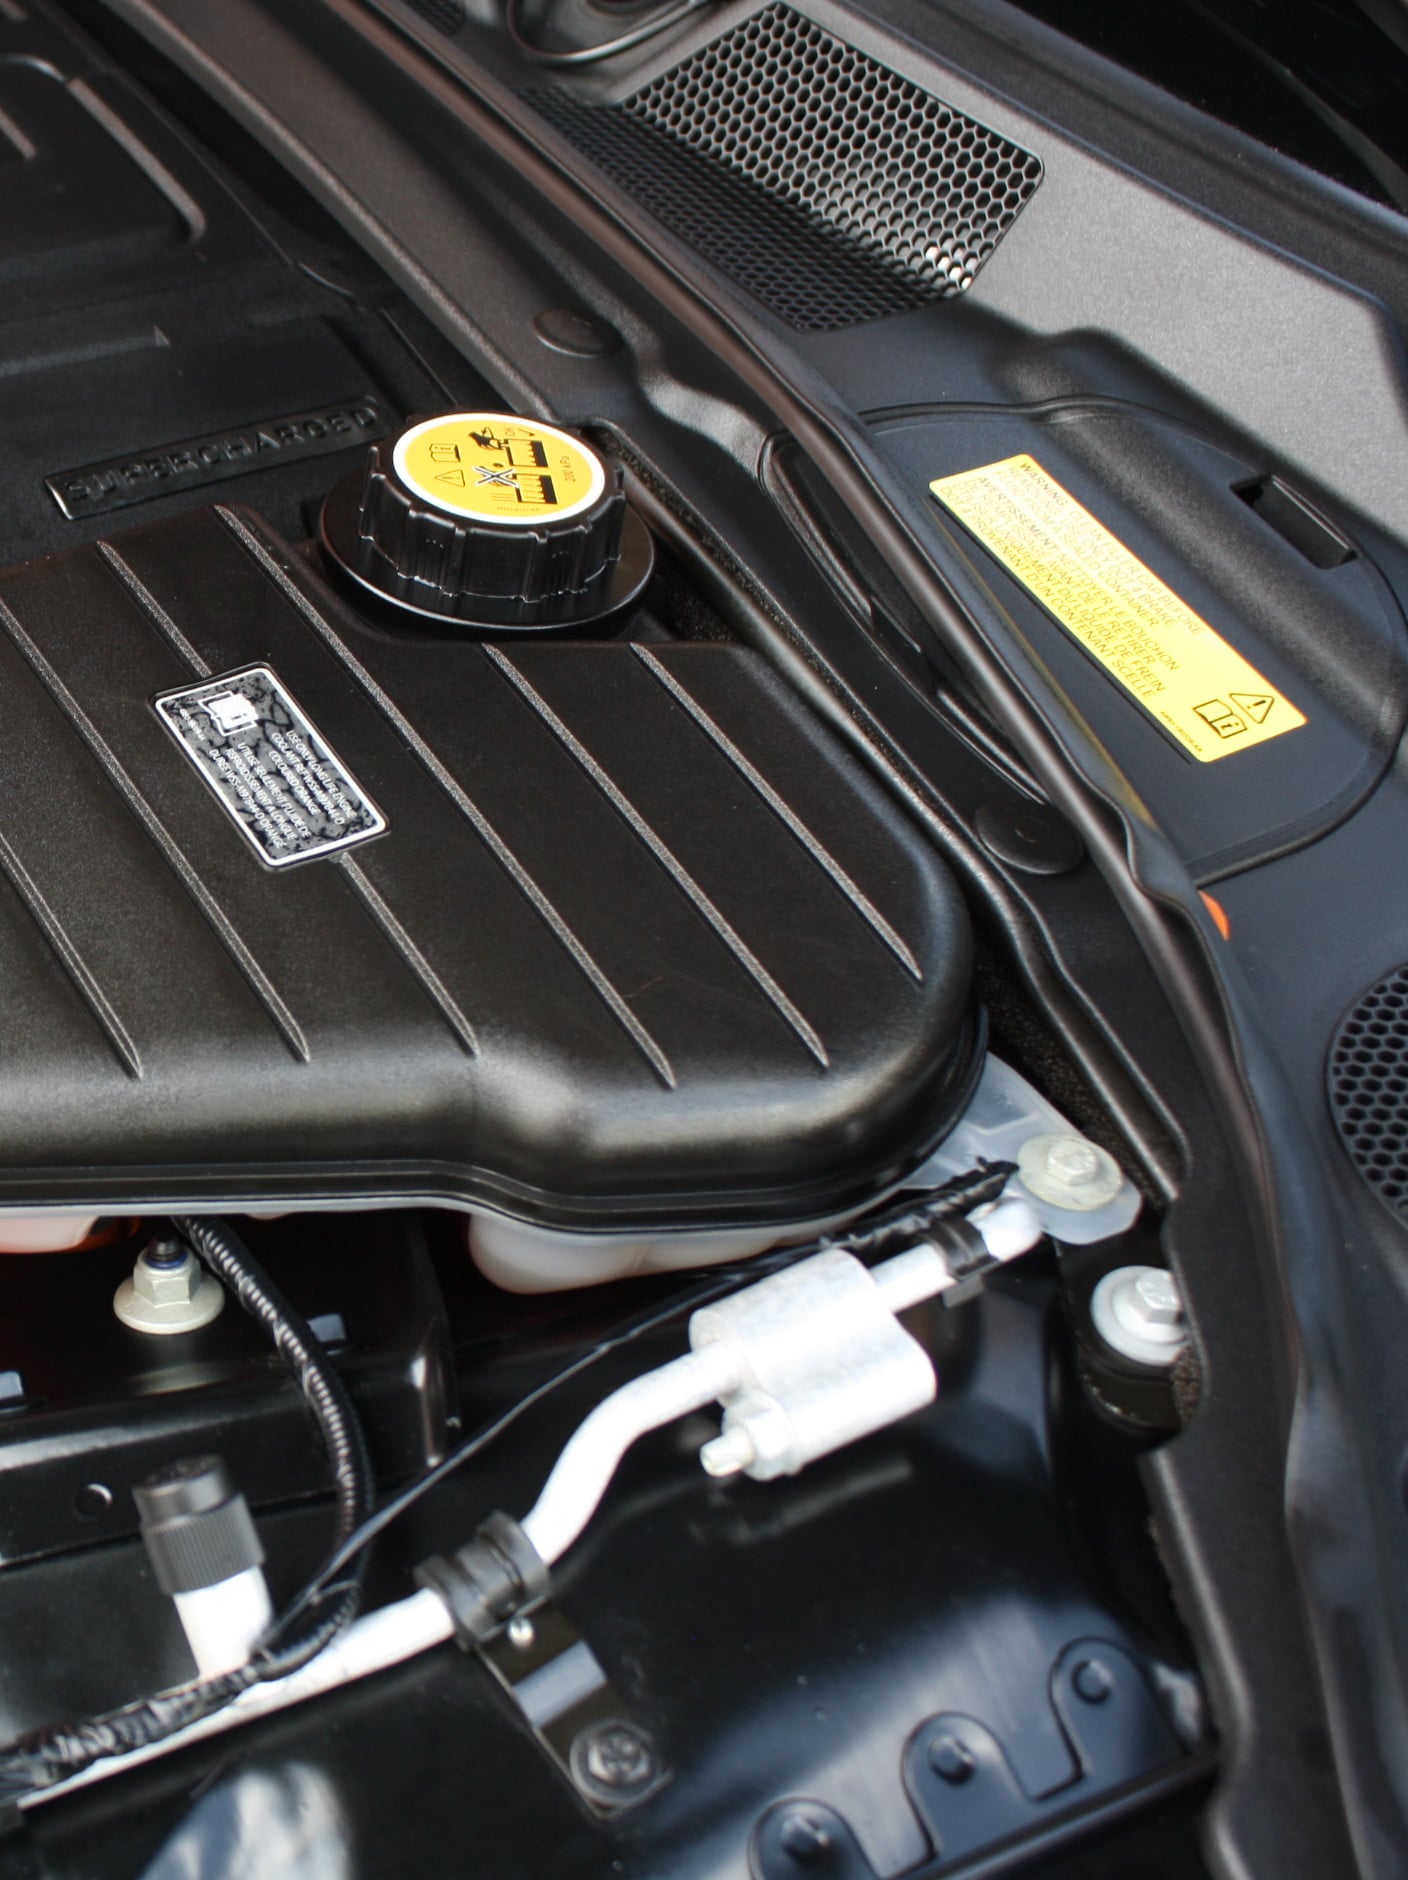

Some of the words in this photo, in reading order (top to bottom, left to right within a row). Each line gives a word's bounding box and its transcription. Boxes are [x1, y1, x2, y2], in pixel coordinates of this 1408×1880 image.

[63, 405, 379, 501] SUPERCHARGED
[991, 470, 1027, 497] FLUID
[962, 479, 985, 495] DE
[976, 493, 1051, 560] REMPLISSAGE
[1043, 558, 1083, 592] AVANT
[1074, 590, 1098, 607] DE
[1090, 605, 1112, 620] LE
[1019, 496, 1057, 526] FROM
[1047, 524, 1066, 535] A
[1056, 532, 1104, 571] SEALED
[938, 486, 965, 506] DOT
[957, 505, 973, 514] 4
[966, 514, 1032, 574] PROVENANT
[1024, 572, 1056, 597] D'UN
[1048, 597, 1117, 659] CONTENANT
[950, 482, 1000, 526] UTILISER
[991, 524, 1063, 588] UNIQUEMENT
[1054, 587, 1079, 605] DU
[1071, 603, 1120, 645] LIQUIDE
[1111, 643, 1135, 660] DE
[1127, 659, 1168, 693] FREIN
[1053, 553, 1115, 606] NETTOYER
[1106, 604, 1129, 620] LE
[1121, 619, 1182, 672] BOUCHON
[1066, 509, 1107, 542] CLEAN
[1099, 540, 1142, 575] FILLER
[1133, 573, 1164, 596] CAP
[1155, 594, 1206, 636] BEFORE
[1078, 537, 1114, 565] ONLY
[1105, 563, 1136, 586] DOT
[1136, 592, 1179, 628] BRAKE
[223, 747, 273, 806] REFROIDISSEMENT
[269, 810, 298, 840] LONGUE
[266, 750, 300, 786] COLOURED
[292, 785, 321, 815] ORANGE
[269, 731, 300, 764] COOLANT
[292, 762, 310, 777] REF
[284, 729, 303, 745] USE
[294, 742, 316, 762] ONLY
[307, 760, 329, 780] LONG
[320, 778, 339, 794] LIFE
[330, 792, 357, 818] ENGINE
[252, 764, 287, 803] SEULEMENT
[279, 802, 305, 828] FLUIDE
[296, 825, 312, 838] DE
